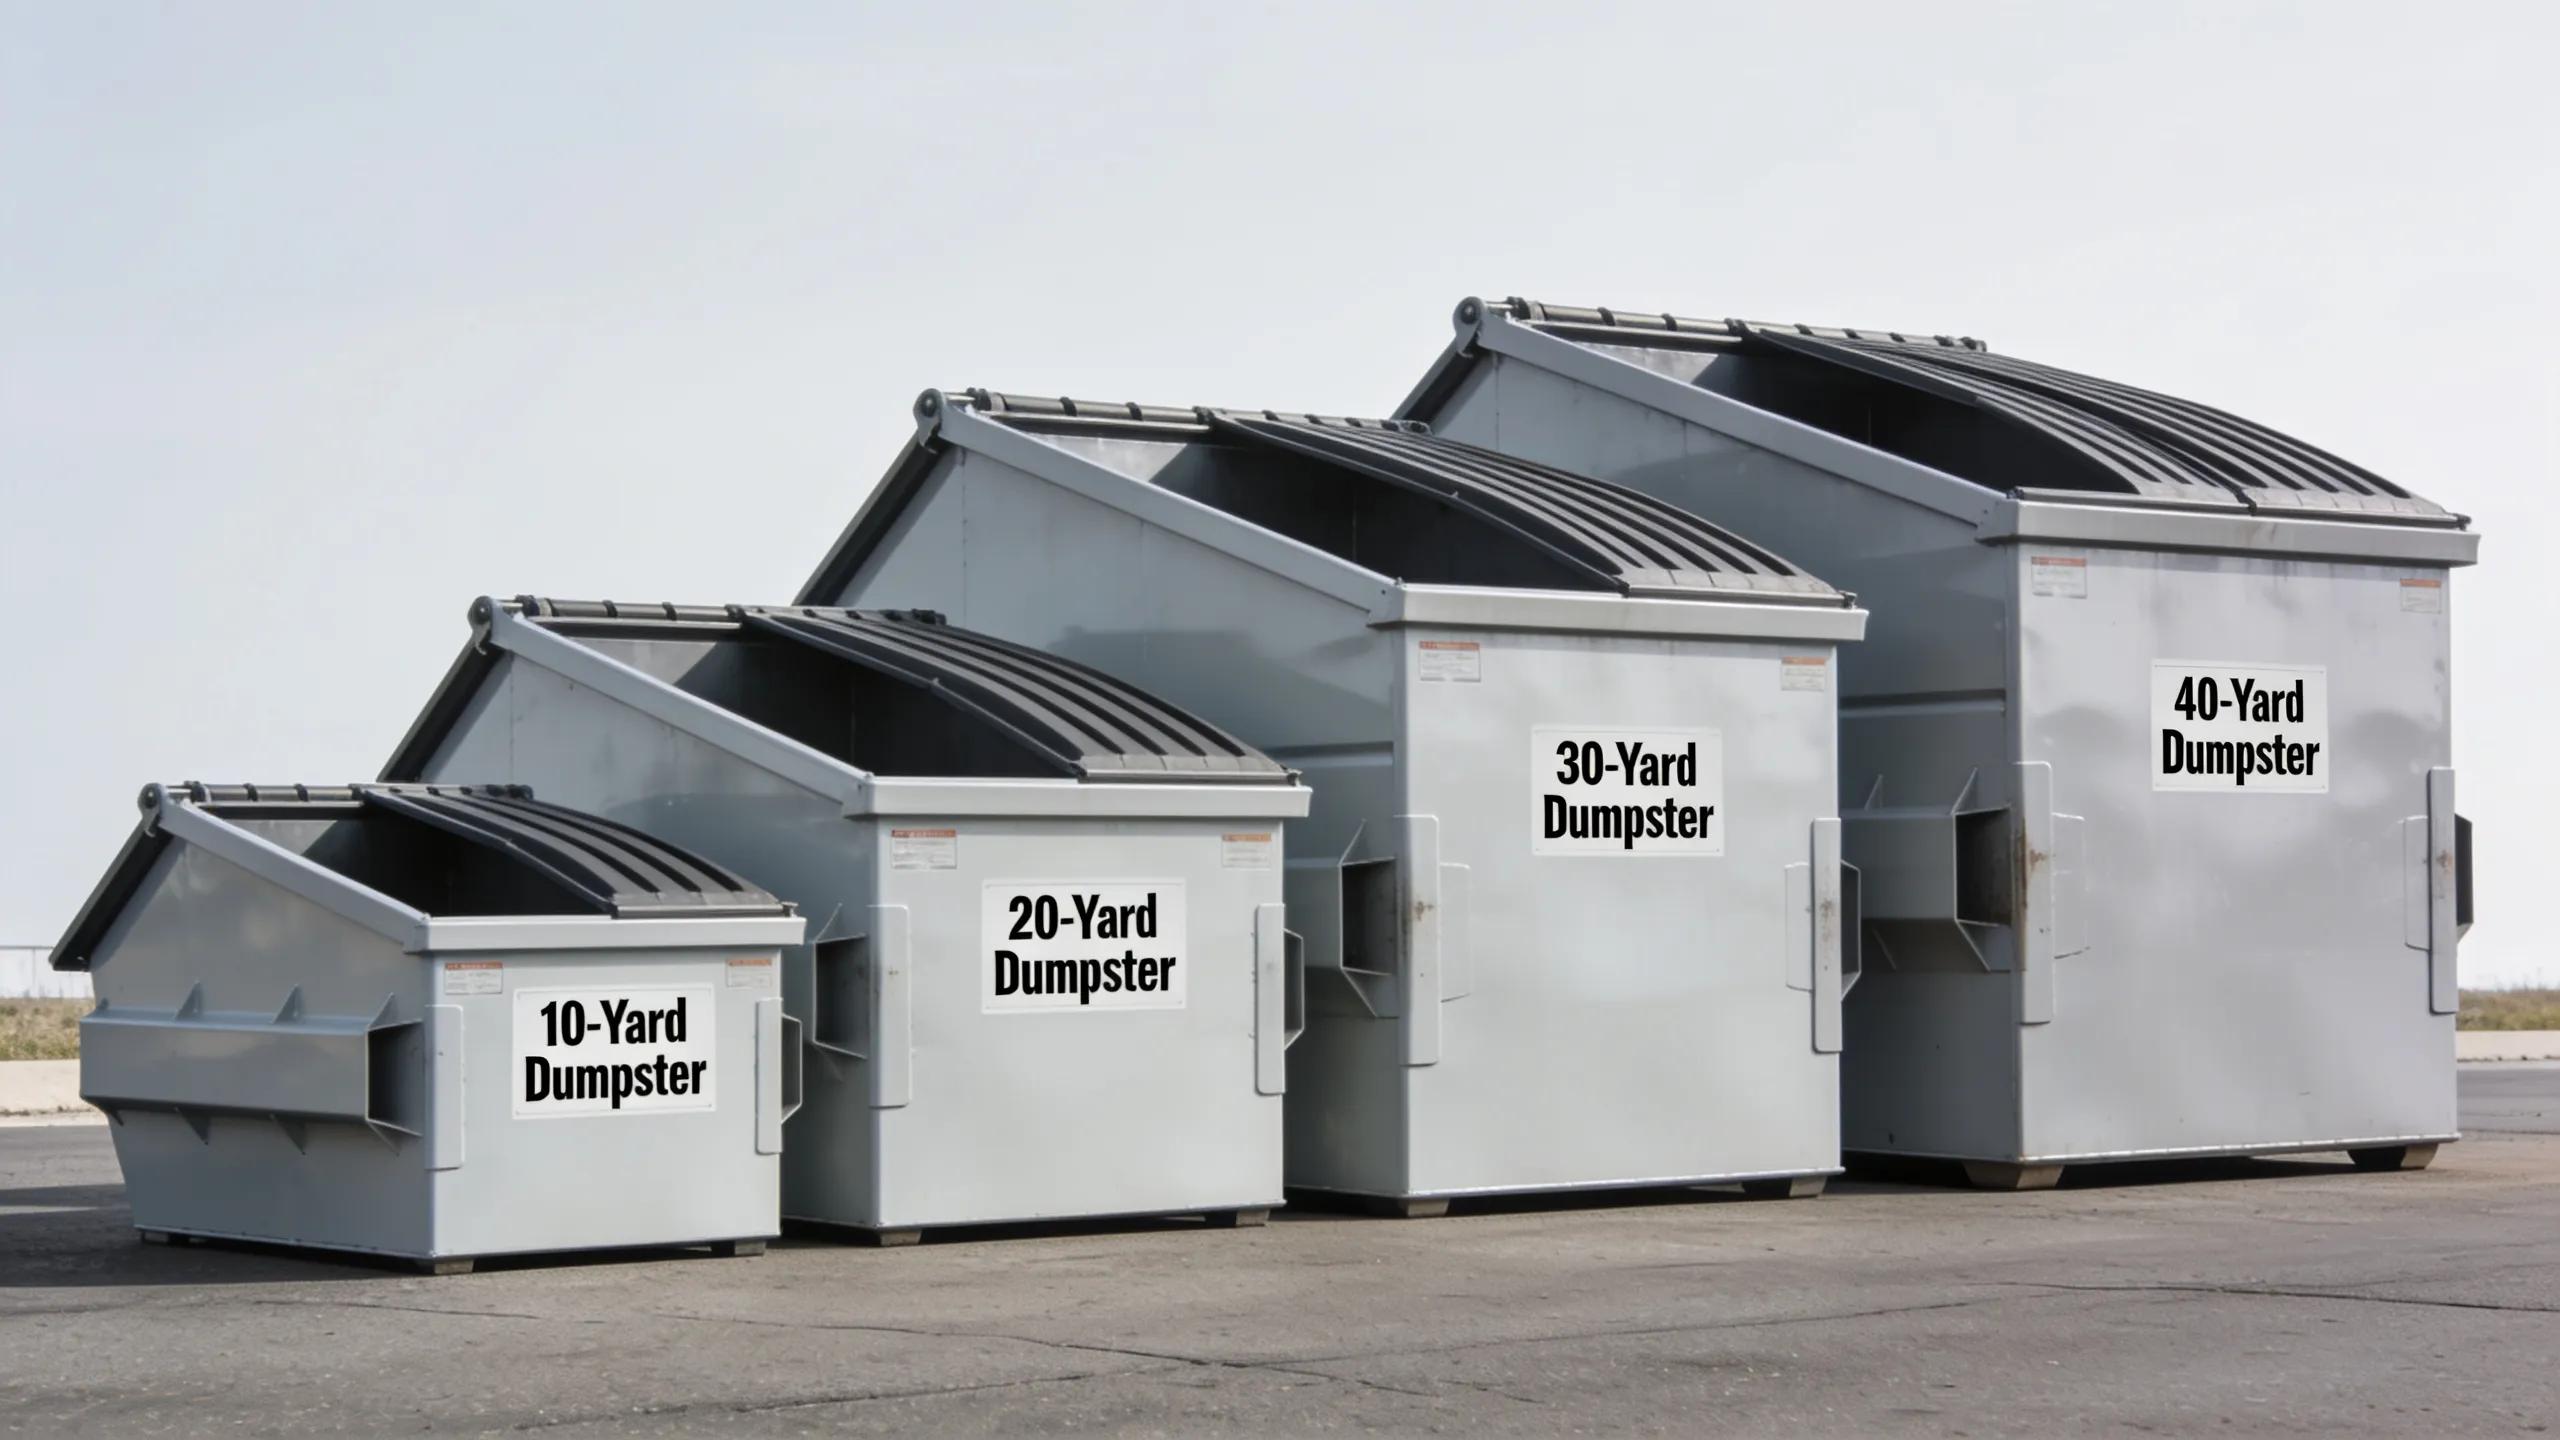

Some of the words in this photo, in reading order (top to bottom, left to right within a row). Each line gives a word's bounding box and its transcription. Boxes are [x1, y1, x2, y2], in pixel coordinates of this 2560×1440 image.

[2174, 676, 2304, 723] 40-Yard
[1556, 740, 1697, 787] 30-Yard
[2162, 728, 2321, 786] Dumpster
[1543, 794, 1714, 850] Dumpster
[1008, 892, 1157, 941] 20-Yard
[994, 950, 1177, 1005] Dumpster
[540, 996, 687, 1047] 10-Yard
[525, 1054, 707, 1110] Dumpster
